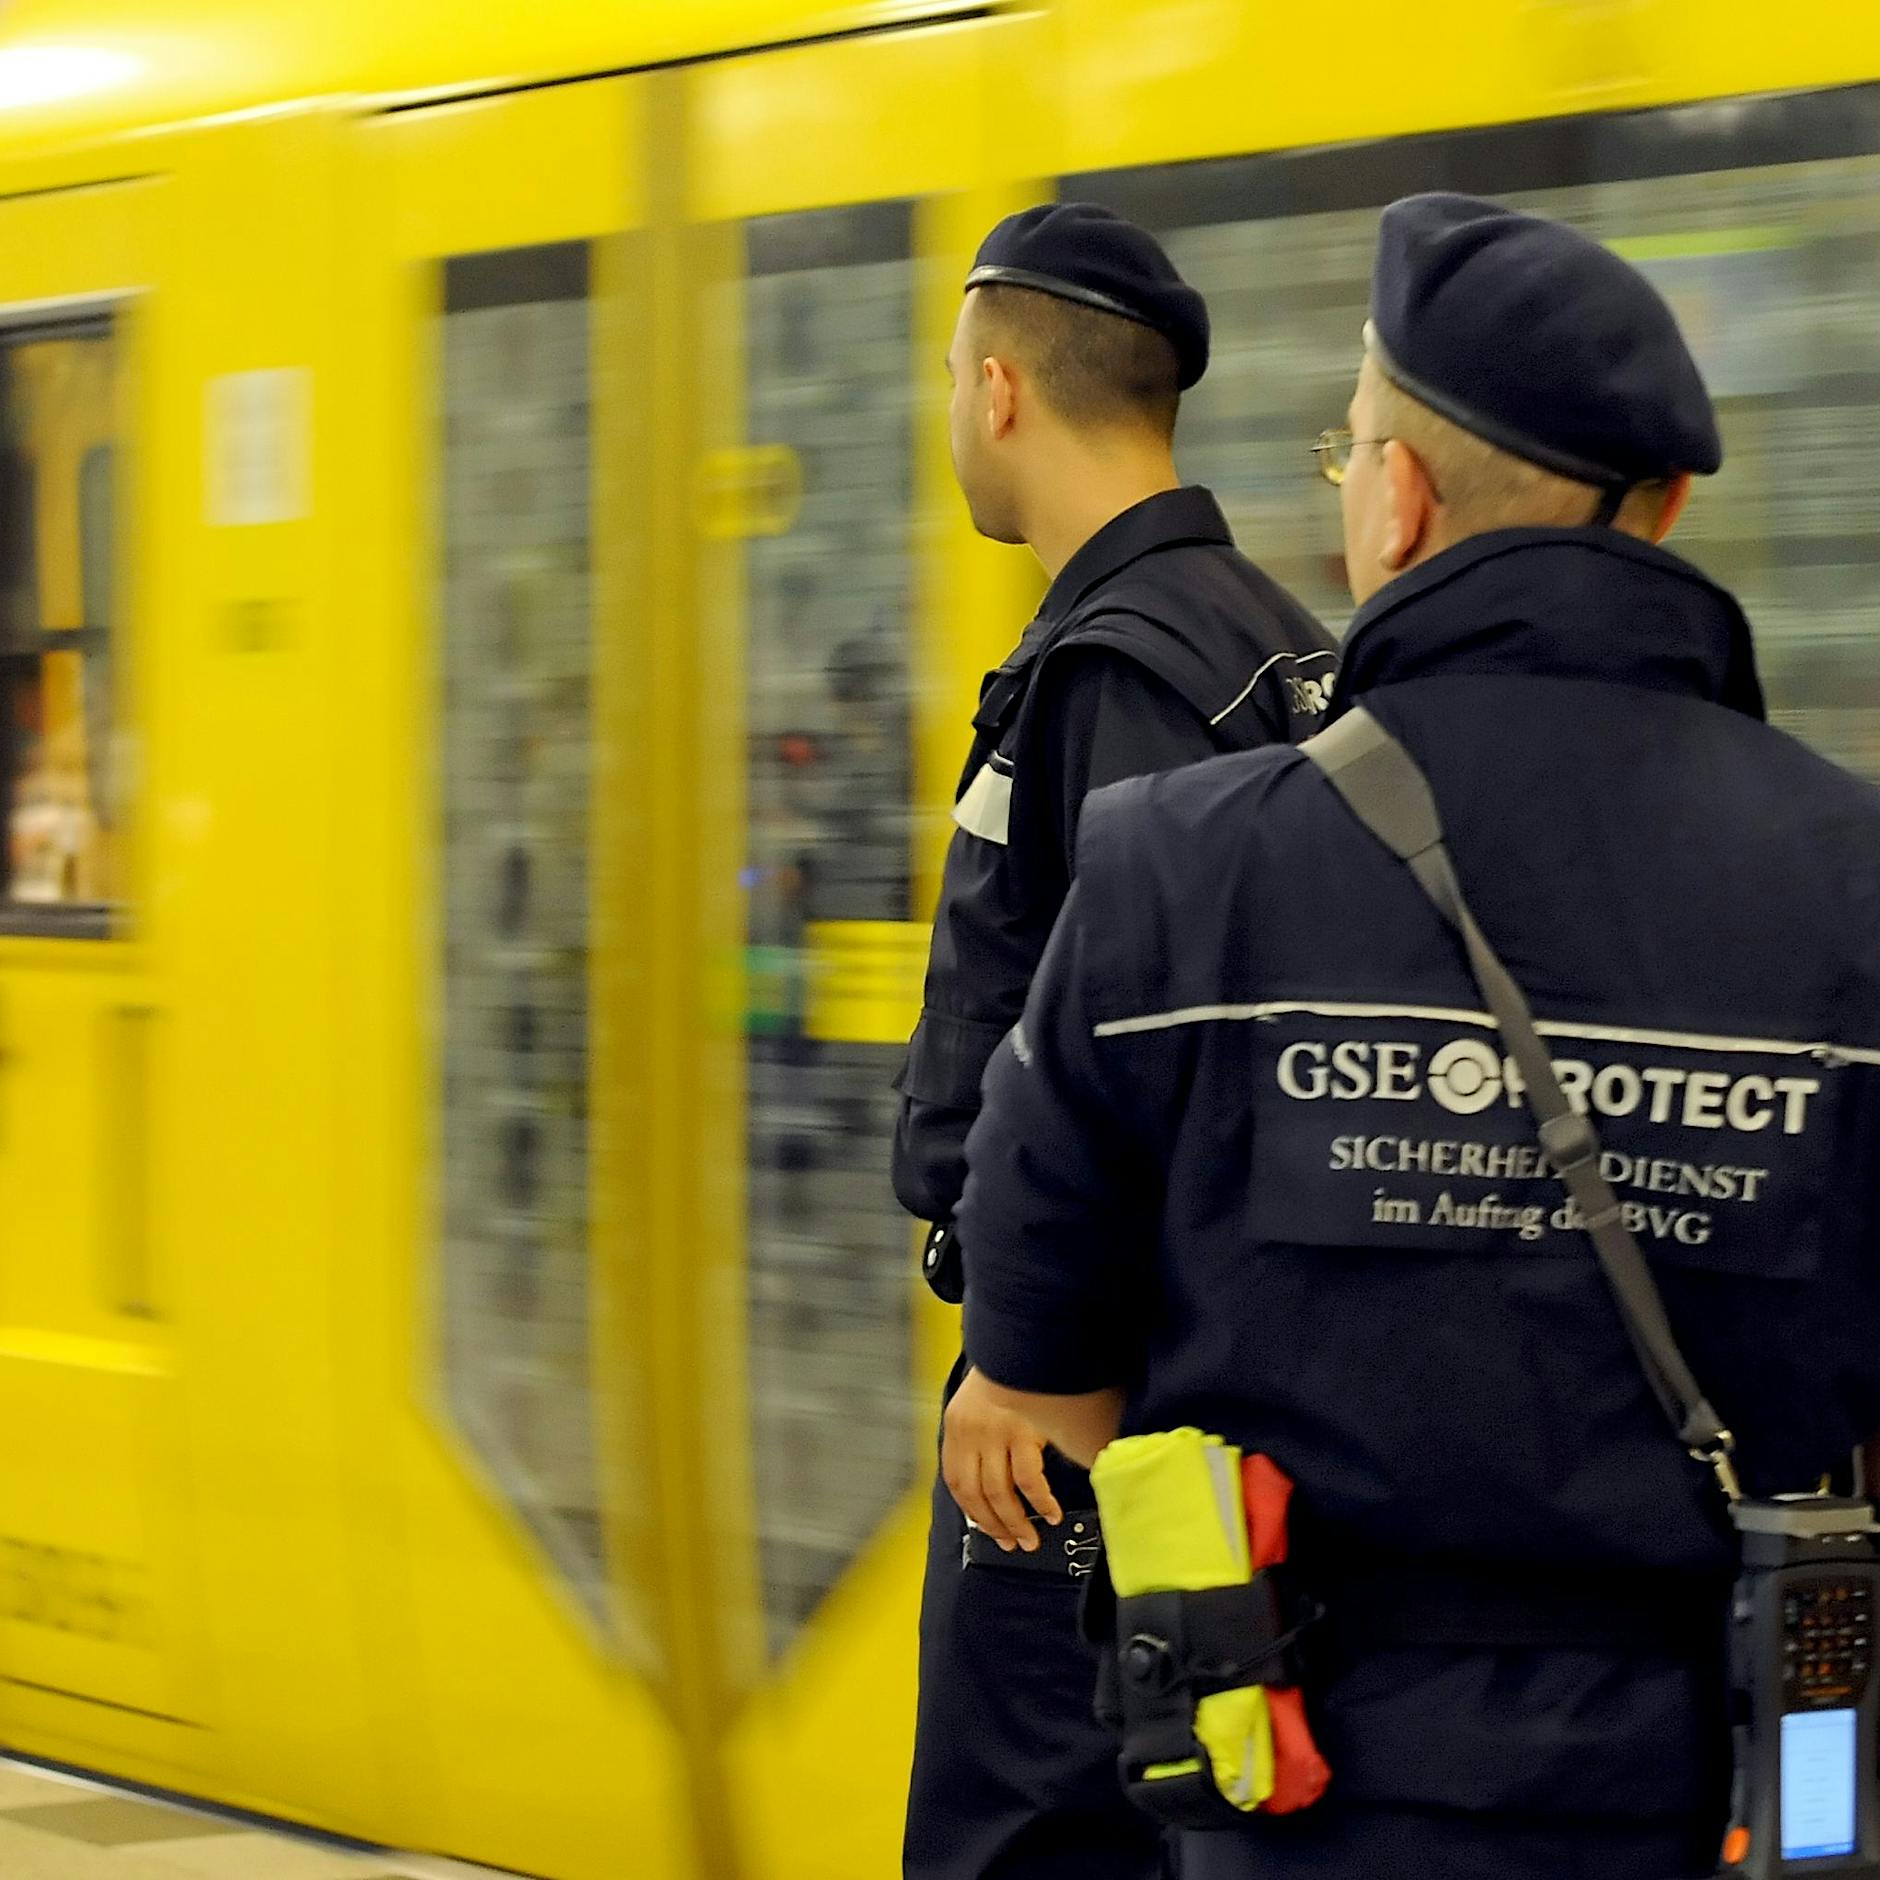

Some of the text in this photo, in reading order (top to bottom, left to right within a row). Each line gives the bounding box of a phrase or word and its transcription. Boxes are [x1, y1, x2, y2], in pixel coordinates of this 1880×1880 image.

[1276, 1040, 1422, 1100] GSE
[1329, 1135, 1768, 1201] SICHERHEIDIENST
[1372, 1187, 1420, 1224] im
[1621, 1201, 1712, 1244] BVG
